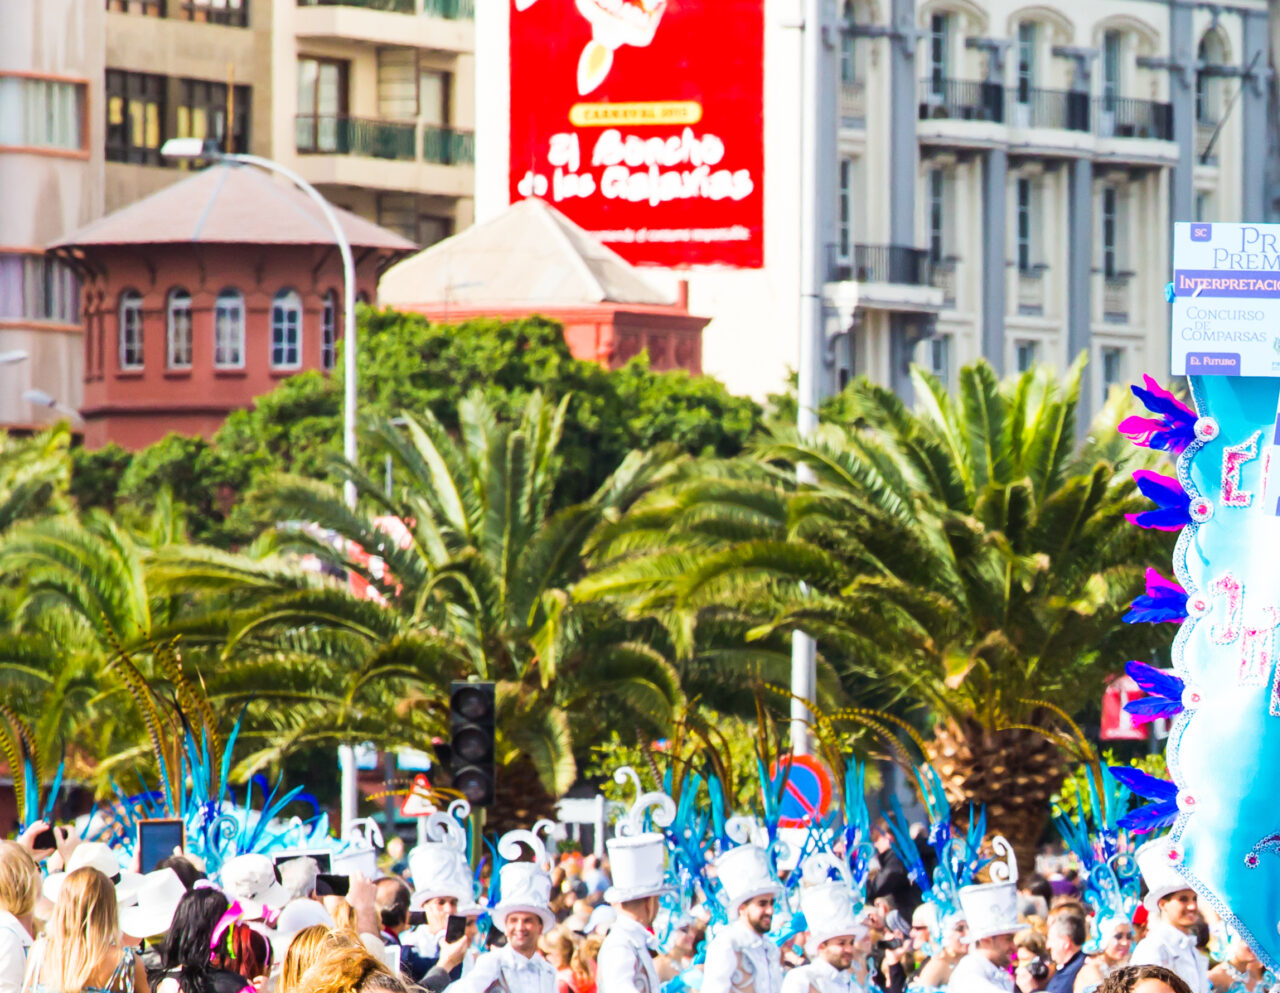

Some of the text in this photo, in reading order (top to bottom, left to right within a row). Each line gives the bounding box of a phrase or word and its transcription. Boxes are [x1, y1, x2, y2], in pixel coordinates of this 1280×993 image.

[1194, 228, 1208, 238] SC
[1186, 306, 1265, 321] CONCURSO
[1194, 321, 1210, 330] DE
[1181, 328, 1267, 342] COMPARSAS
[1190, 356, 1236, 366] EL FUTURO
